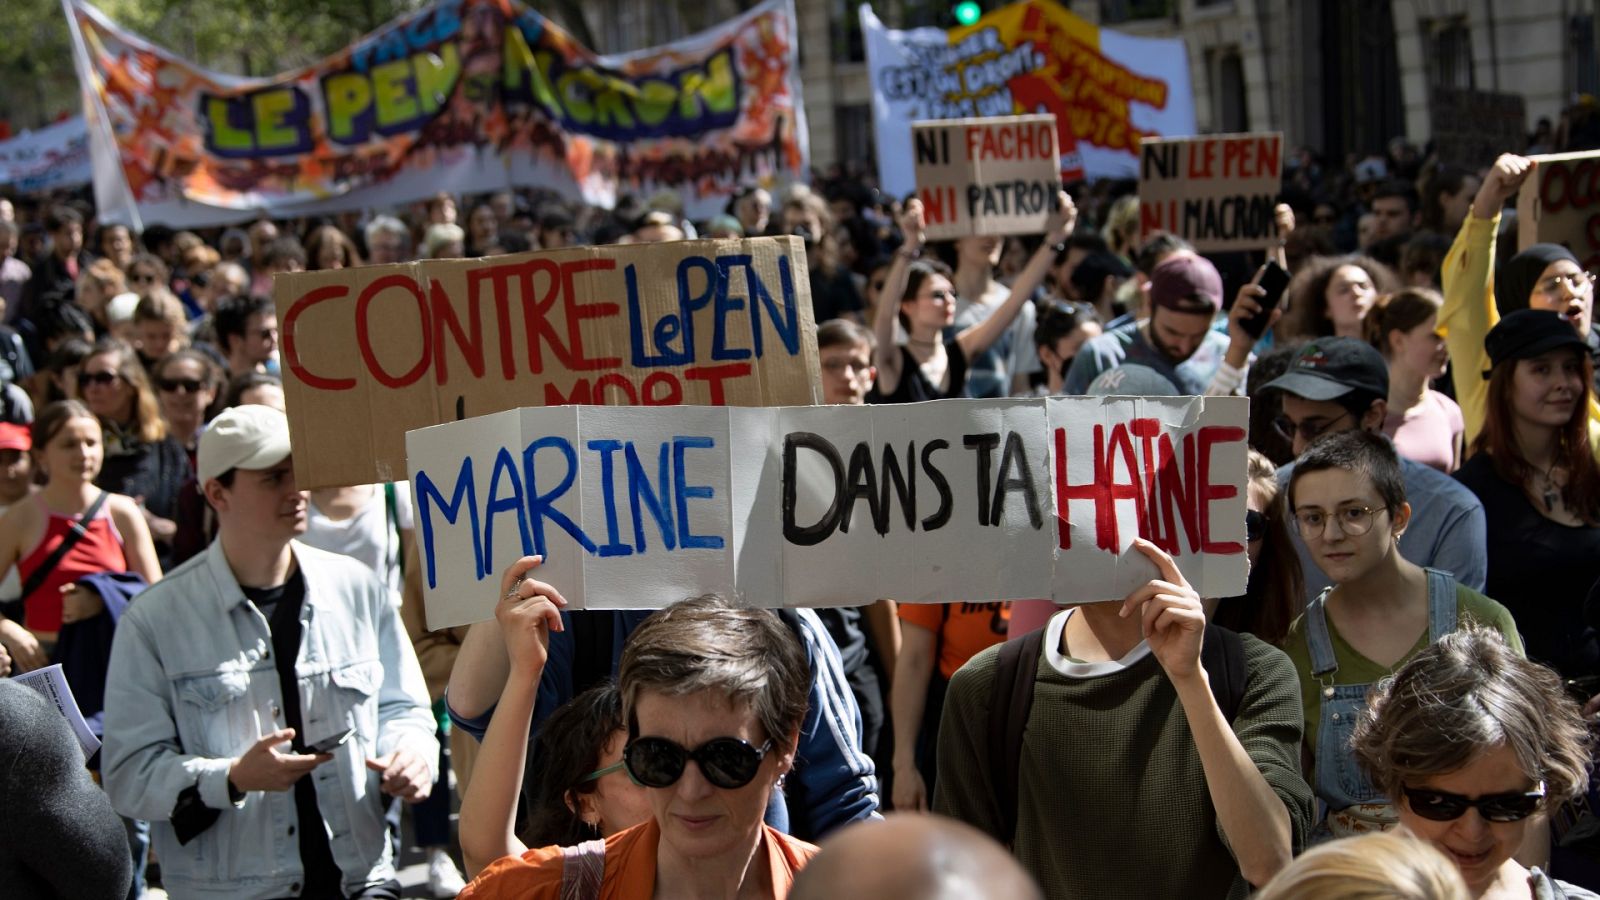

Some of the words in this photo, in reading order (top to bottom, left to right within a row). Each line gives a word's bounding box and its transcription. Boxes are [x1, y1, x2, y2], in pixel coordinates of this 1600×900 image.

[205, 91, 300, 149] LE
[323, 41, 462, 139] PEN
[915, 128, 950, 166] NI
[965, 123, 1053, 162] FACHO
[1144, 143, 1179, 180] NI
[1187, 140, 1217, 180] LE
[1223, 136, 1280, 179] PEN
[922, 184, 959, 225] NI
[967, 178, 1061, 218] PATRON
[1140, 198, 1178, 241] NI
[1184, 194, 1281, 240] MACRON
[282, 258, 623, 391] CONTRE
[415, 436, 725, 590] MARINE
[781, 431, 954, 546] DANS
[963, 430, 1043, 530] TA
[1055, 417, 1247, 556] HAINE
